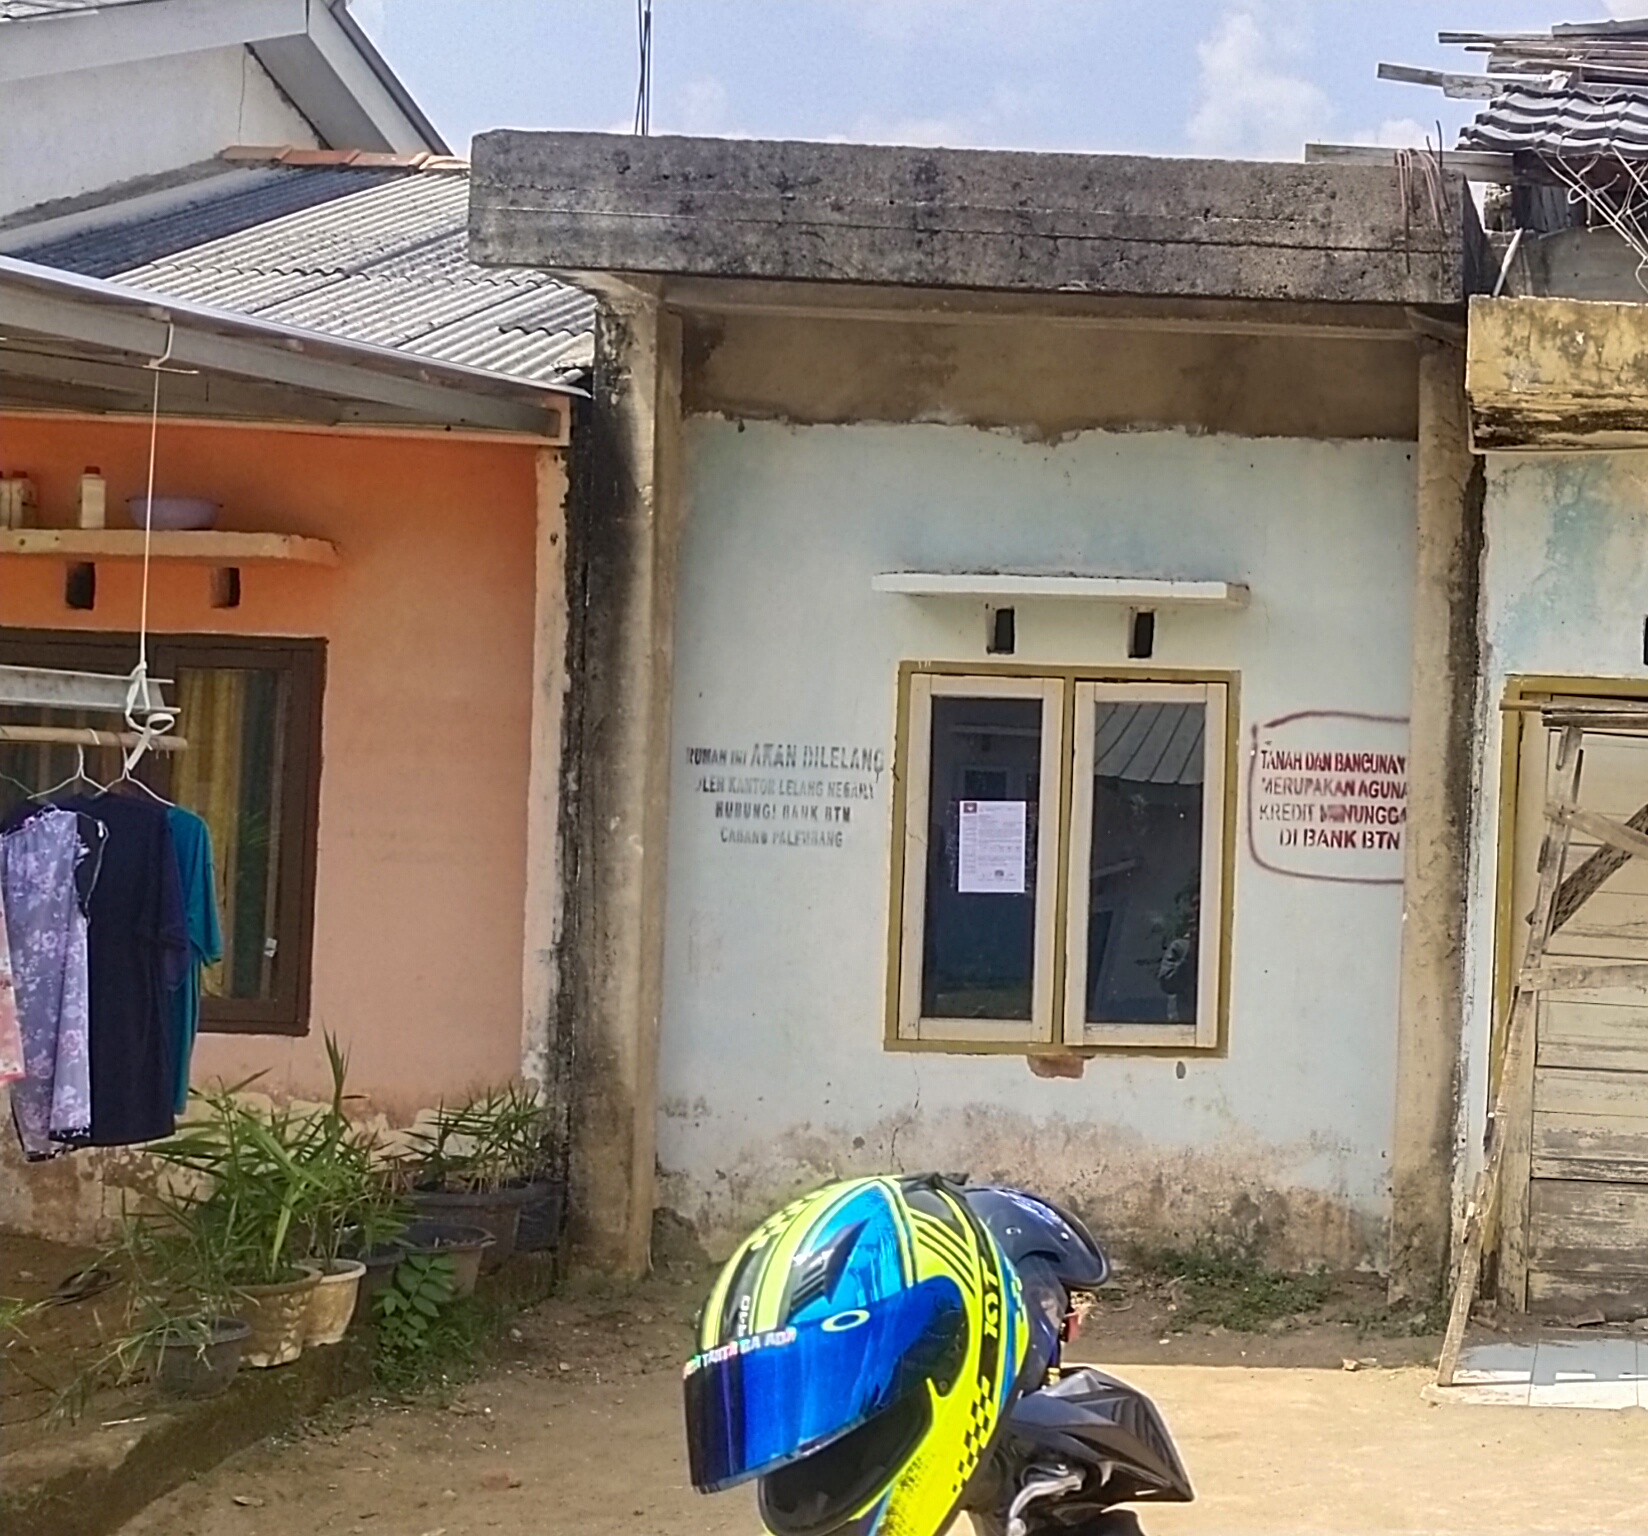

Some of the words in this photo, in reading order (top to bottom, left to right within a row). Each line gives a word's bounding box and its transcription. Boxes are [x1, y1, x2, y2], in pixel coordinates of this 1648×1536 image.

[750, 743, 797, 768] AKAN
[803, 744, 885, 774] DILELANG
[1261, 750, 1302, 771] TANAH
[1305, 752, 1332, 773] DAN
[778, 779, 824, 799] LELANG
[1262, 777, 1355, 798] MERUPAKAN
[782, 804, 818, 823] BANK
[824, 806, 851, 823] BTN
[1259, 803, 1316, 822] KREDIT
[1279, 828, 1298, 847] DI
[1303, 828, 1357, 848] BANK
[1362, 830, 1401, 851] BTN
